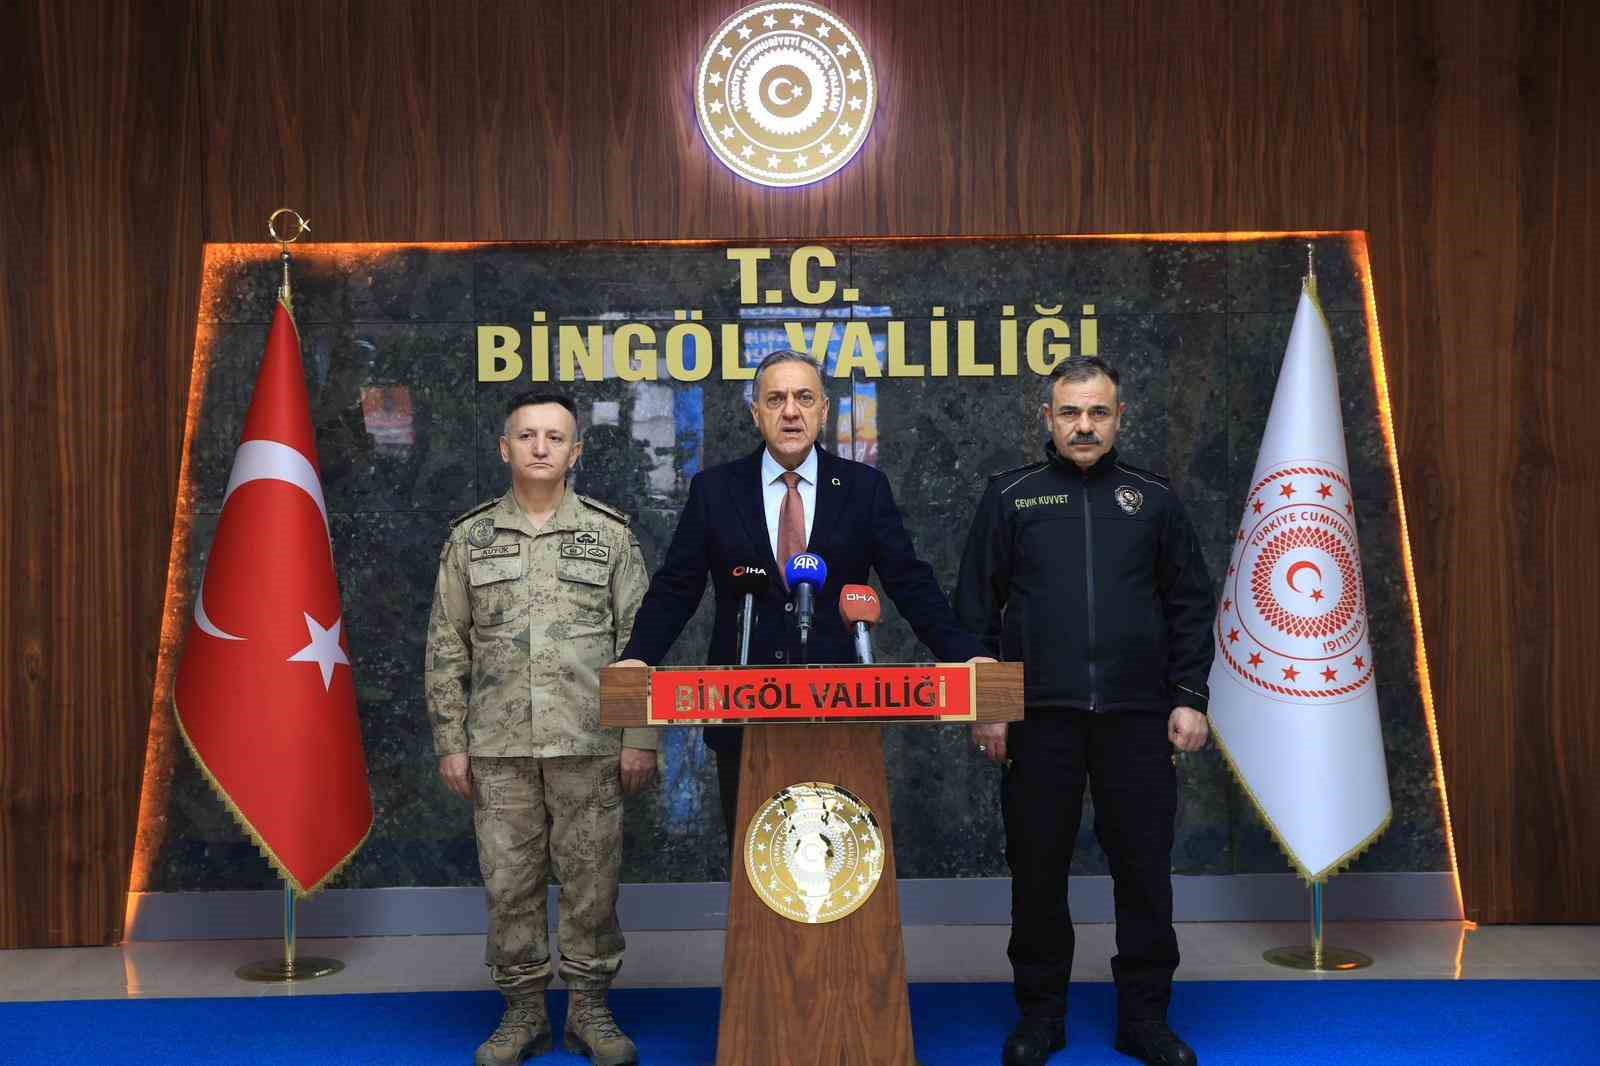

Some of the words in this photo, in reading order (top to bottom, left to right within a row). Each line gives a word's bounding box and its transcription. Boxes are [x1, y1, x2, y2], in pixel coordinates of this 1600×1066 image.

[727, 246, 859, 304] T.C.
[478, 310, 757, 383] BİNGÖL
[784, 304, 1098, 379] VALİLİĞİ
[1039, 494, 1069, 505] KUVVET
[793, 555, 818, 570] AA
[846, 593, 877, 604] DHA
[675, 677, 801, 712] BİNGÖL
[810, 675, 947, 710] VALİLİĞİ
